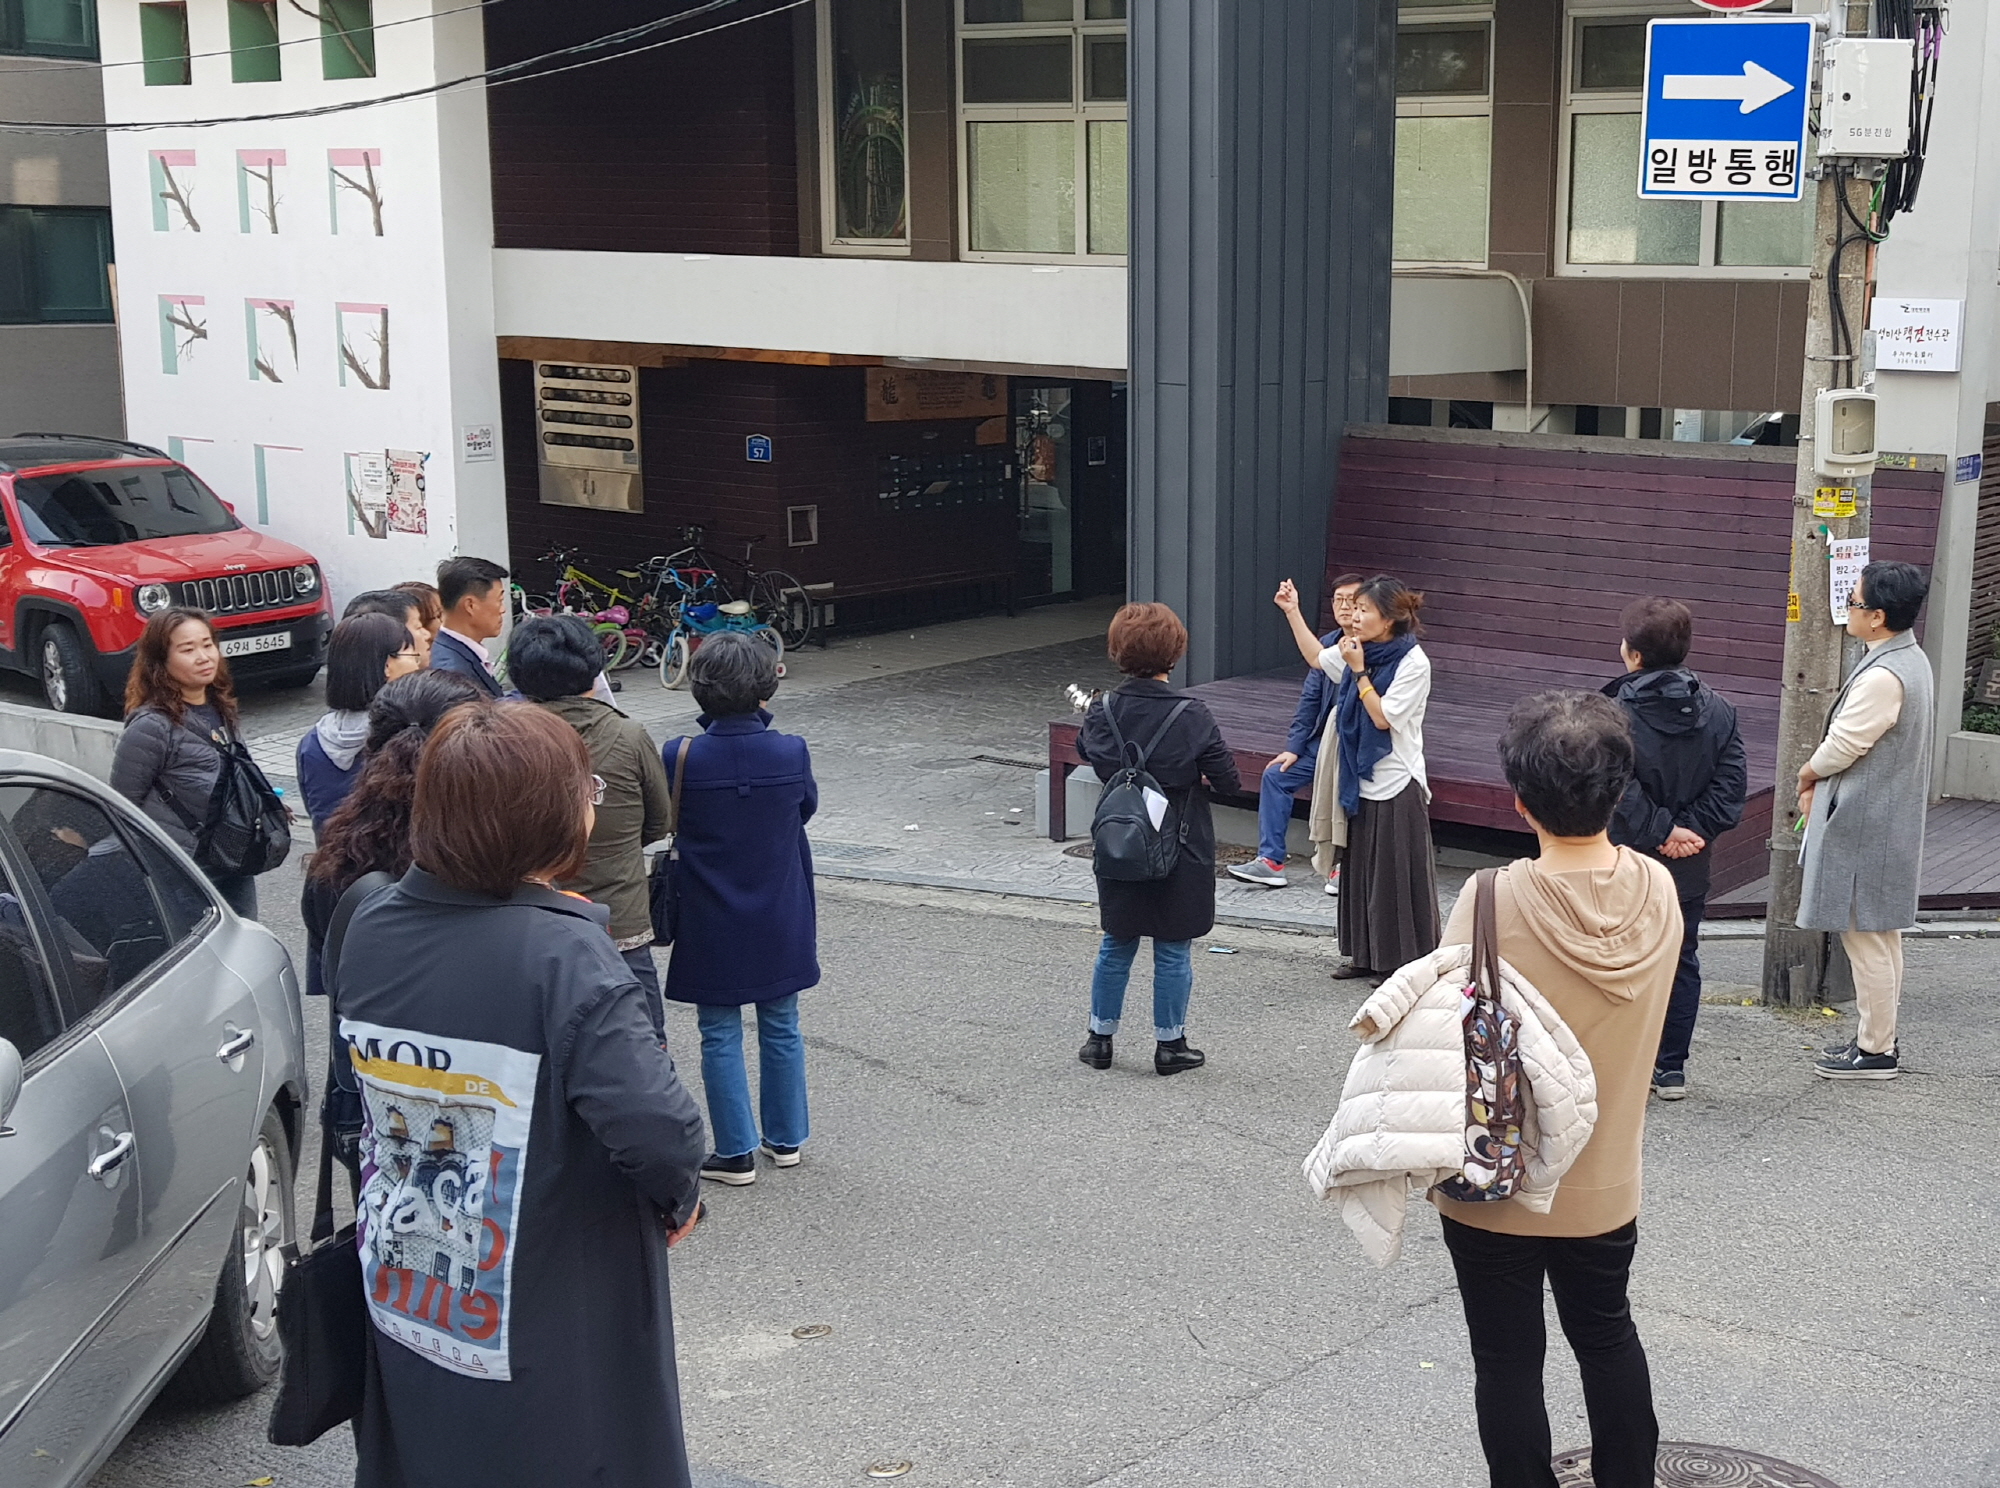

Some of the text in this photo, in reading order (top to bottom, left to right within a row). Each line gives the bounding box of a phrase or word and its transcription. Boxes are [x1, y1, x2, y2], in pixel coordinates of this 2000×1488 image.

[1651, 148, 1794, 187] 일방통행
[753, 447, 764, 459] 57
[255, 635, 285, 651] 5645
[465, 1080, 490, 1095] DE
